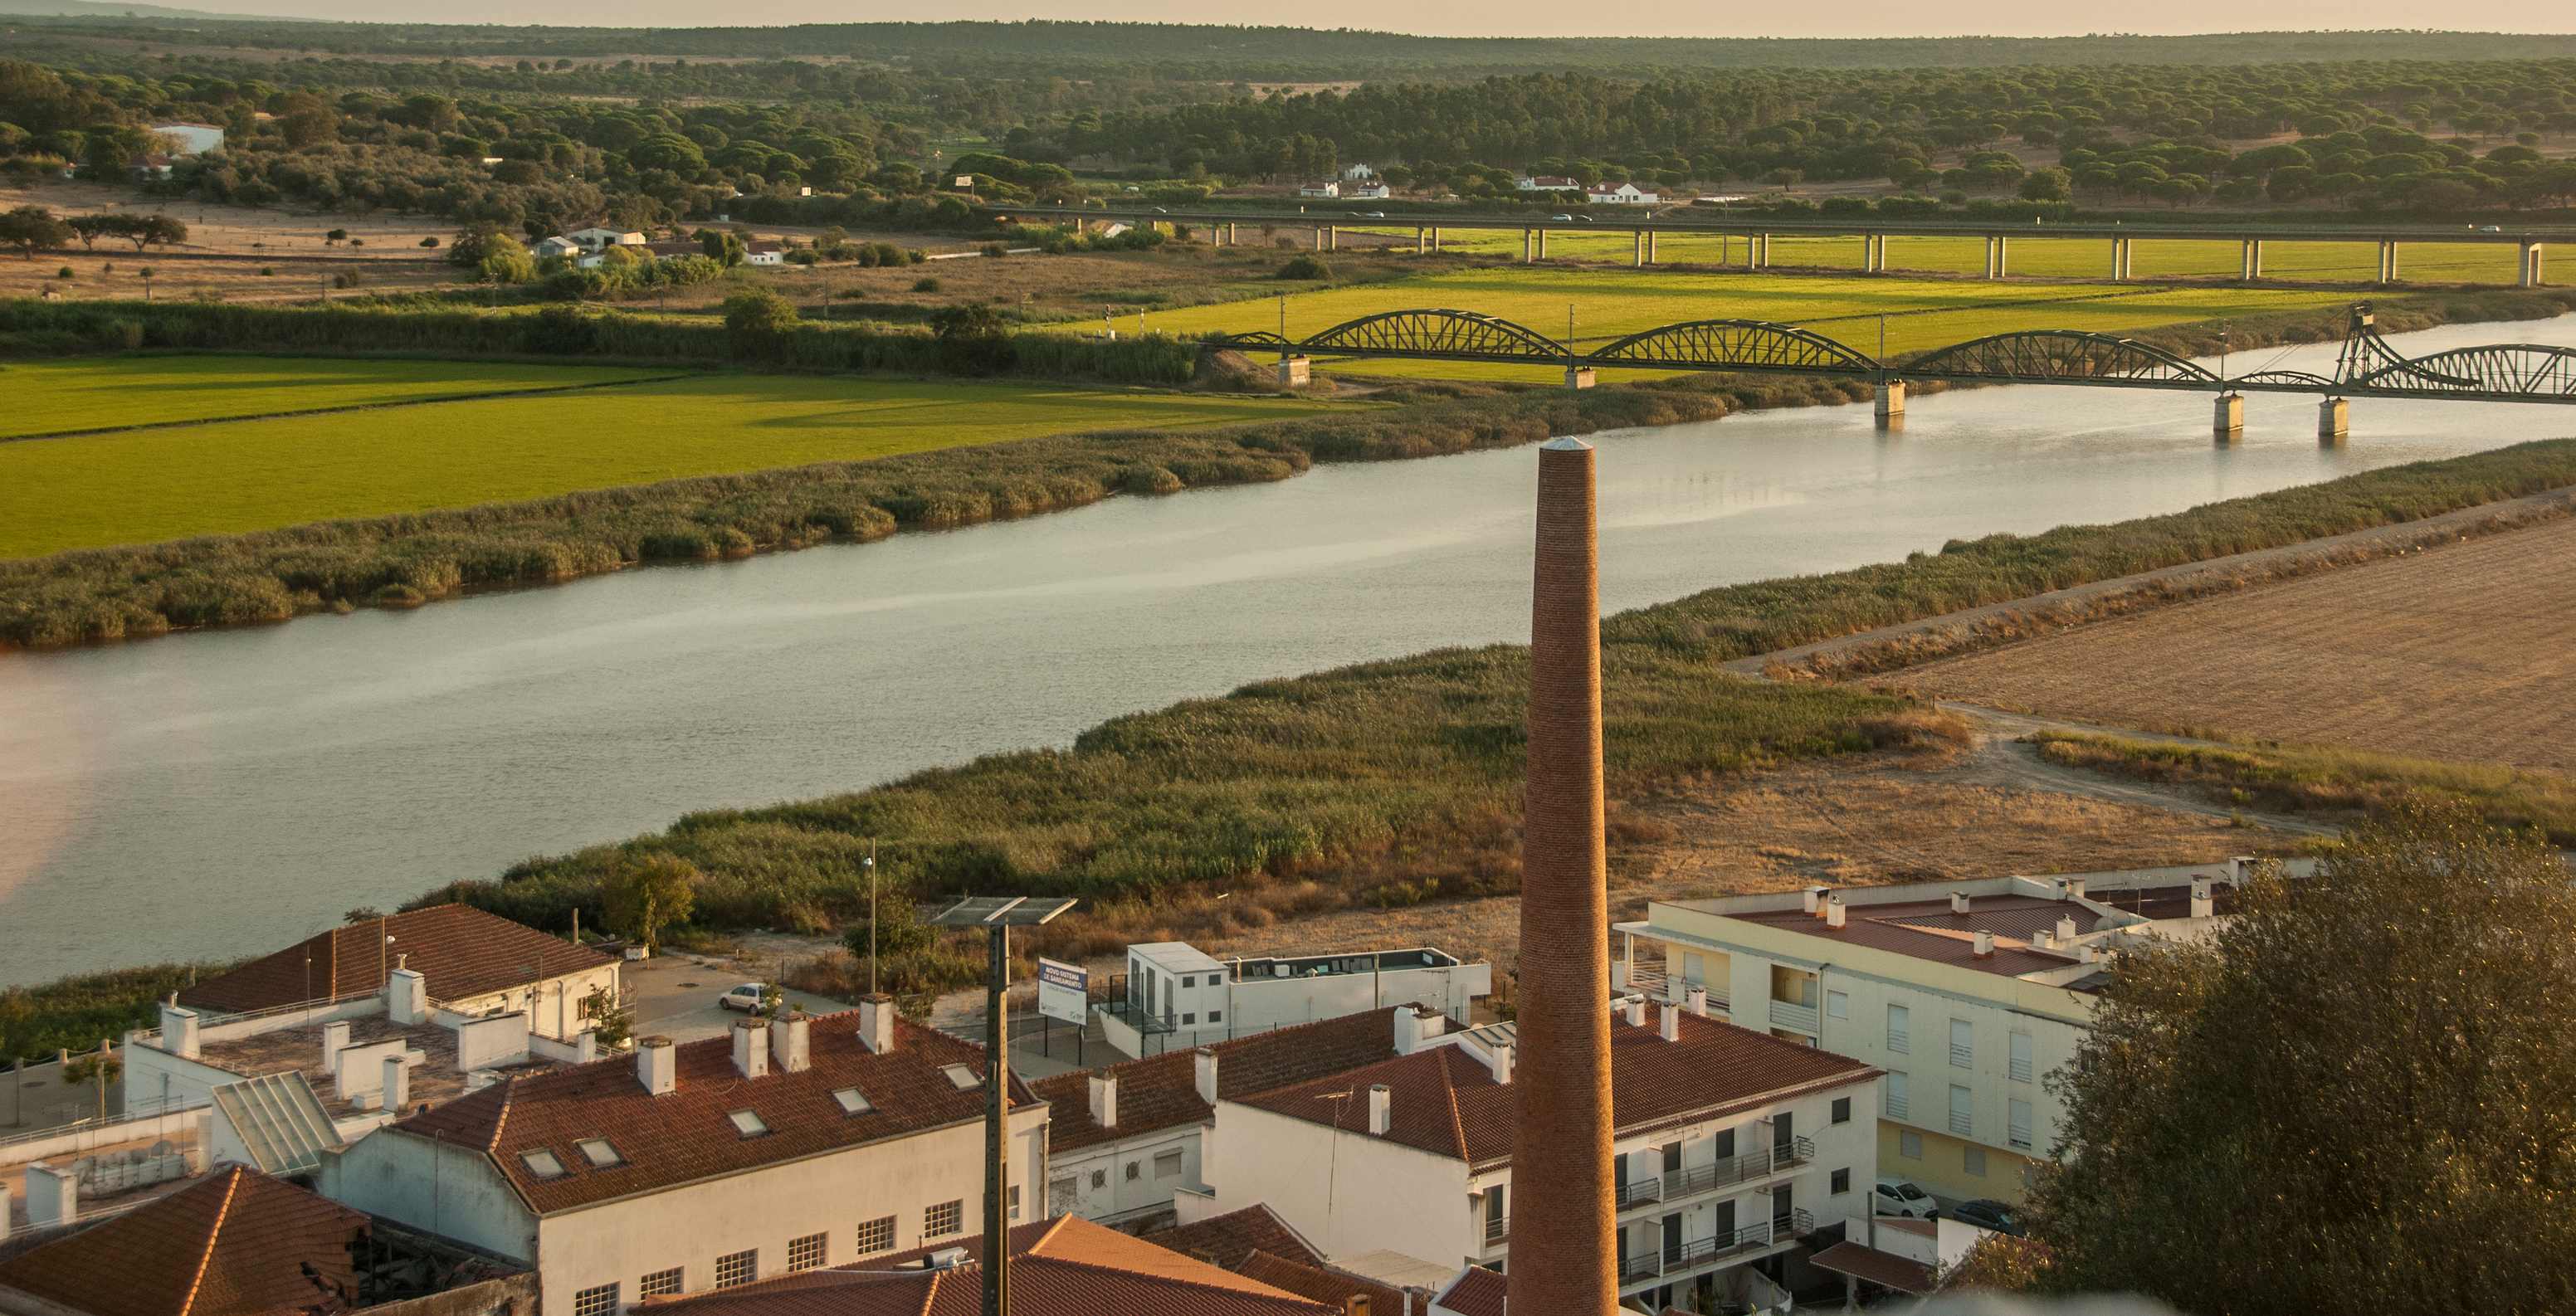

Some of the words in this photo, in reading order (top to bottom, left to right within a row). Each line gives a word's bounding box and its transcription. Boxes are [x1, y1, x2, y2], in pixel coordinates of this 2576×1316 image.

[1046, 967, 1060, 976] NOVO
[1060, 970, 1079, 981] SISTEMA
[1050, 975, 1081, 988] SANEAMENTO
